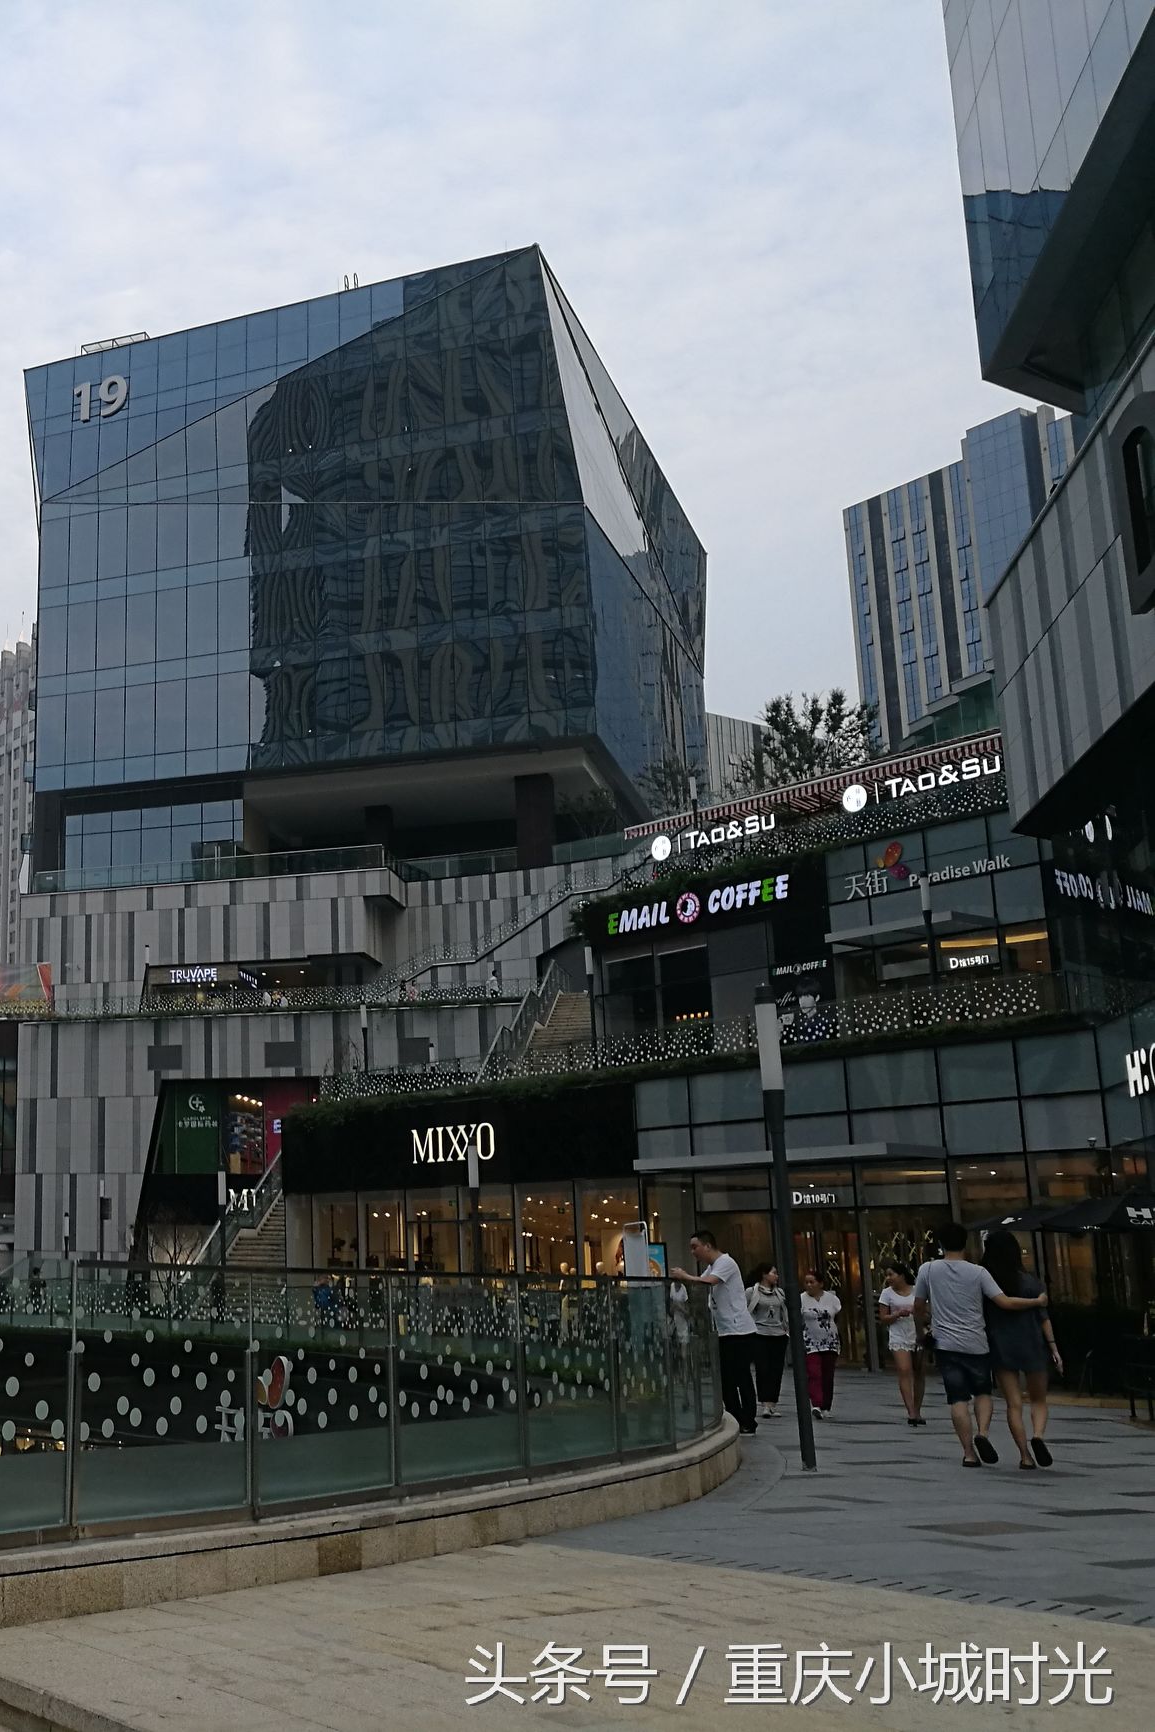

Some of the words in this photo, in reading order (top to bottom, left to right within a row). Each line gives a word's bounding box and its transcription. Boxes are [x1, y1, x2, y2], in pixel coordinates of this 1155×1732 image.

[74, 375, 127, 421] 19
[884, 755, 1001, 798] TAO&SU
[686, 814, 776, 849] TAO&SU
[844, 868, 888, 900] 天街
[909, 864, 971, 887] Pradise
[972, 853, 1011, 875] Walk
[608, 901, 670, 935] EMAIL
[708, 874, 789, 914] COFFEE
[410, 1122, 496, 1164] MIXXO
